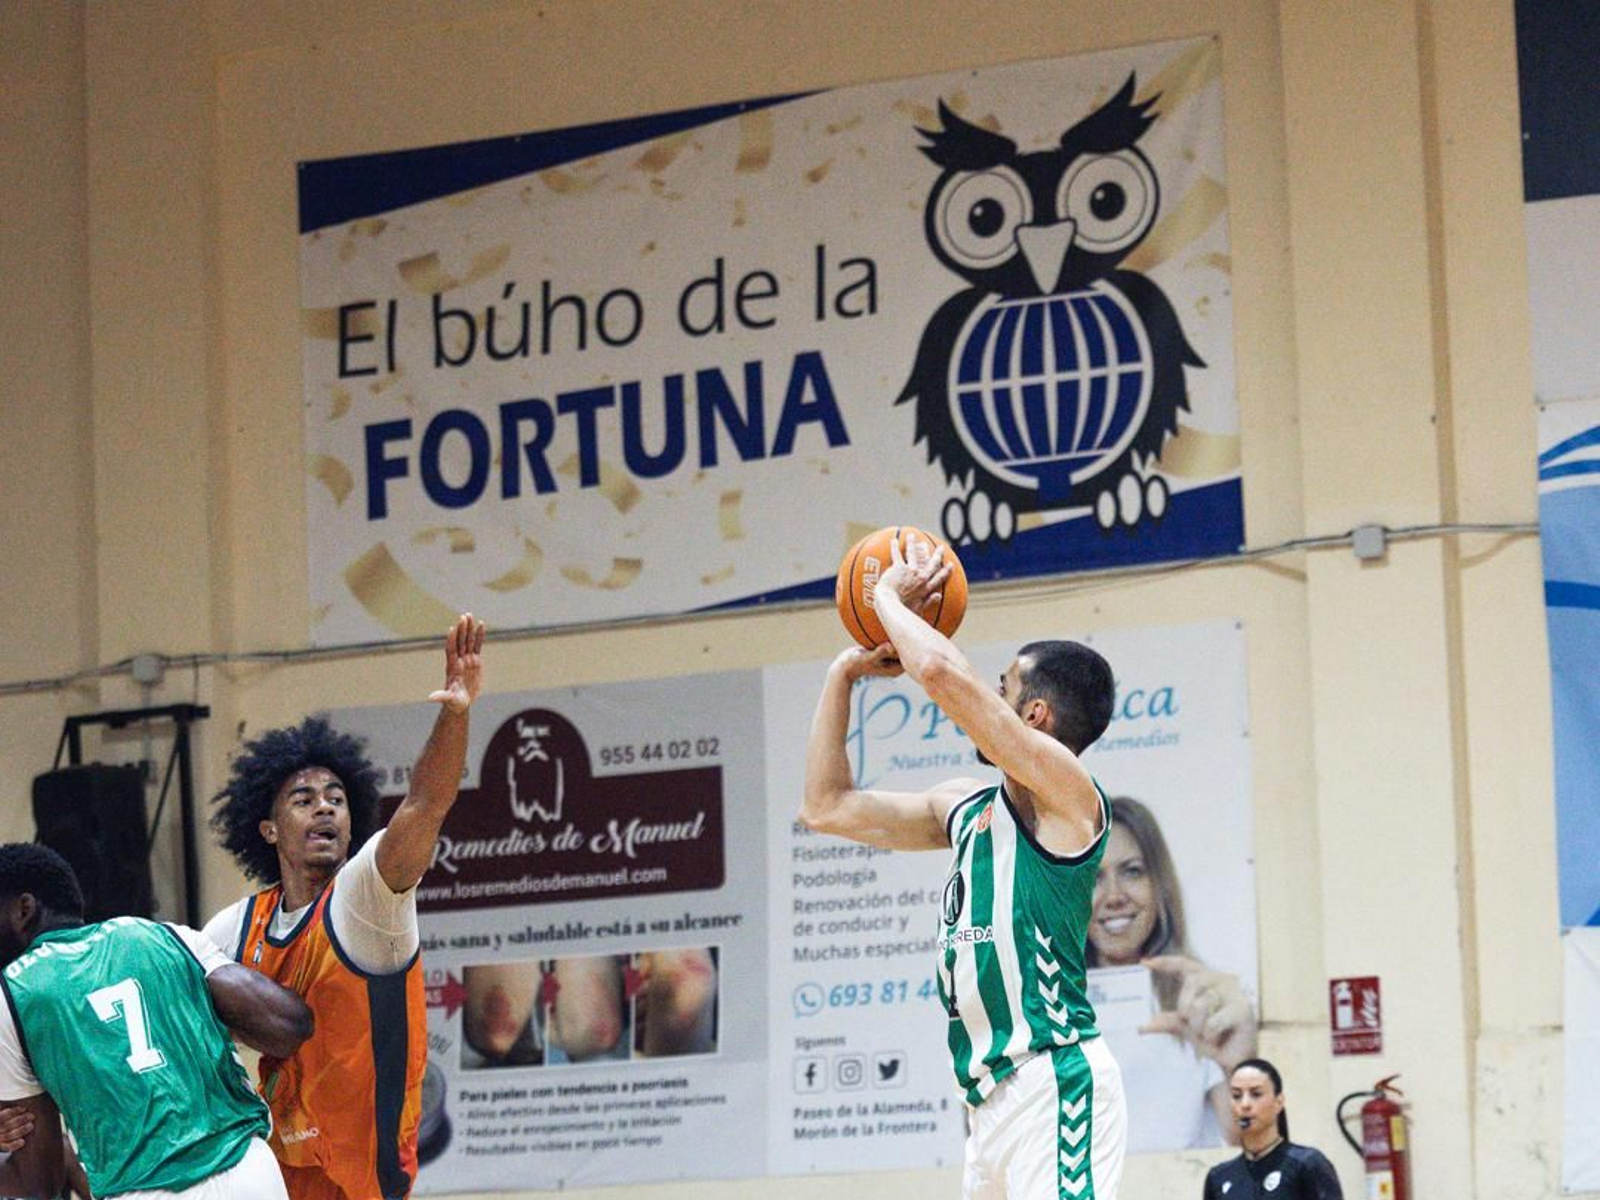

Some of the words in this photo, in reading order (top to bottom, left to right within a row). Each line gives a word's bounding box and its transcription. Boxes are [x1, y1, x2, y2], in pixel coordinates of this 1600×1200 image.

[338, 299, 397, 380] El
[432, 279, 644, 369] búho
[677, 256, 780, 337] de
[814, 243, 879, 323] la
[364, 350, 851, 522] FORTUNA
[599, 745, 635, 766] 955
[641, 743, 663, 762] 44
[668, 740, 691, 760] 02
[696, 736, 721, 757] 02
[428, 829, 547, 873] Remedios
[552, 822, 583, 851] de
[588, 811, 706, 858] Manuel
[793, 867, 877, 888] Podología
[793, 893, 894, 914] Renovación
[897, 888, 926, 906] del
[450, 935, 490, 949] sana
[508, 922, 592, 945] saludable
[596, 916, 632, 938] está
[636, 922, 647, 936] a
[673, 911, 743, 934] alcance
[793, 921, 814, 937] de
[818, 916, 893, 936] conducir
[898, 917, 909, 933] y
[794, 944, 861, 963] Muchas
[865, 937, 937, 960] especial
[829, 982, 873, 1008] 693
[880, 979, 909, 1004] 81
[87, 977, 167, 1076] 7
[794, 1105, 832, 1120] Paseo
[836, 1103, 853, 1117] de
[856, 1101, 869, 1116] la
[842, 1124, 858, 1139] de
[861, 1122, 874, 1136] la
[877, 1119, 937, 1136] Frontera
